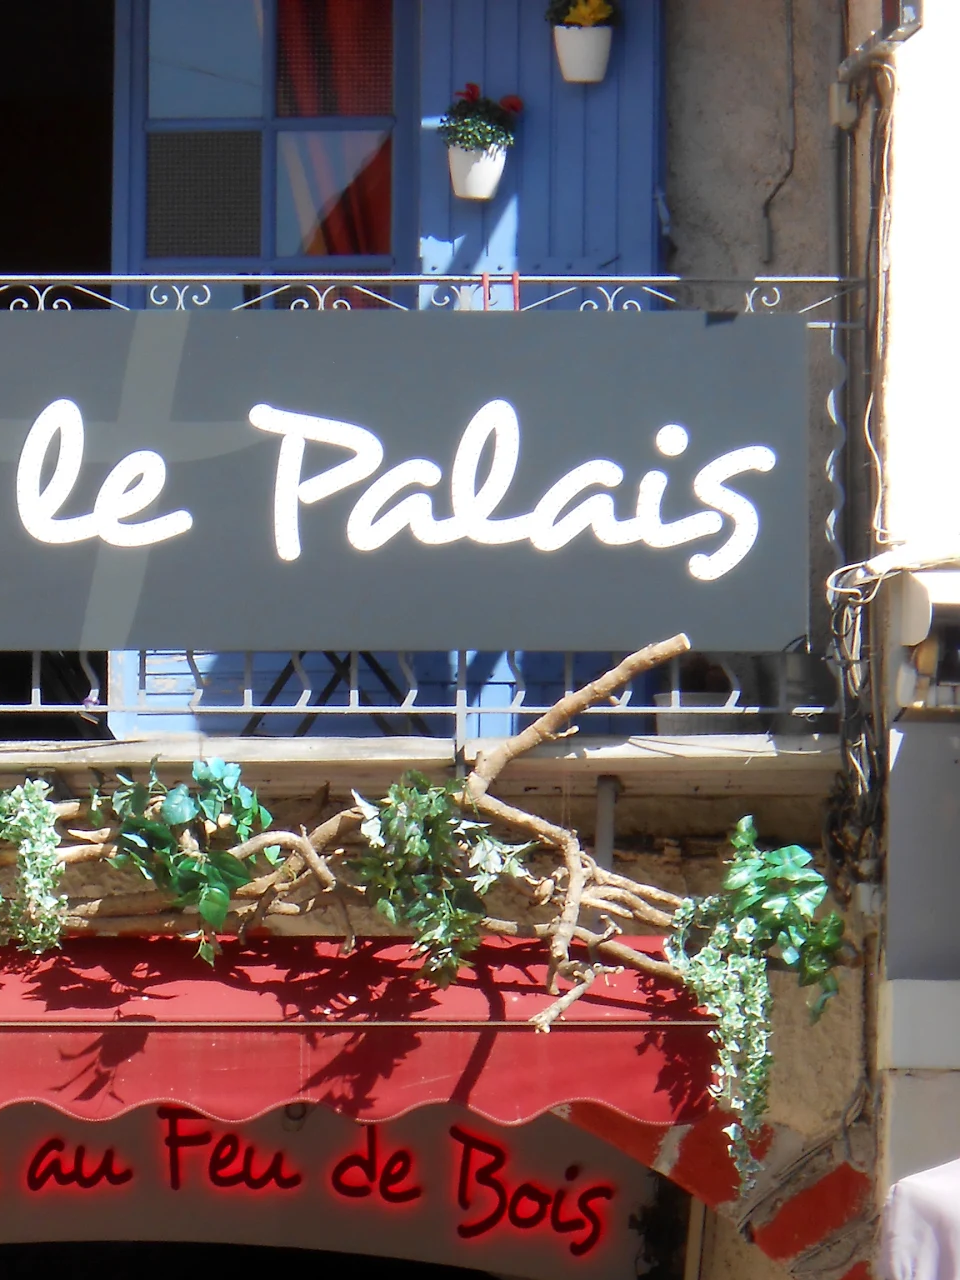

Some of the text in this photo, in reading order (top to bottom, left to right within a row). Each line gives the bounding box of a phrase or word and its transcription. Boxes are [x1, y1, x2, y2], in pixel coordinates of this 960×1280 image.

[15, 397, 194, 548] le
[248, 398, 777, 582] Palais
[26, 1137, 133, 1191] au
[156, 1105, 303, 1191] Feu
[331, 1123, 423, 1204] de
[449, 1125, 614, 1257] Bois
